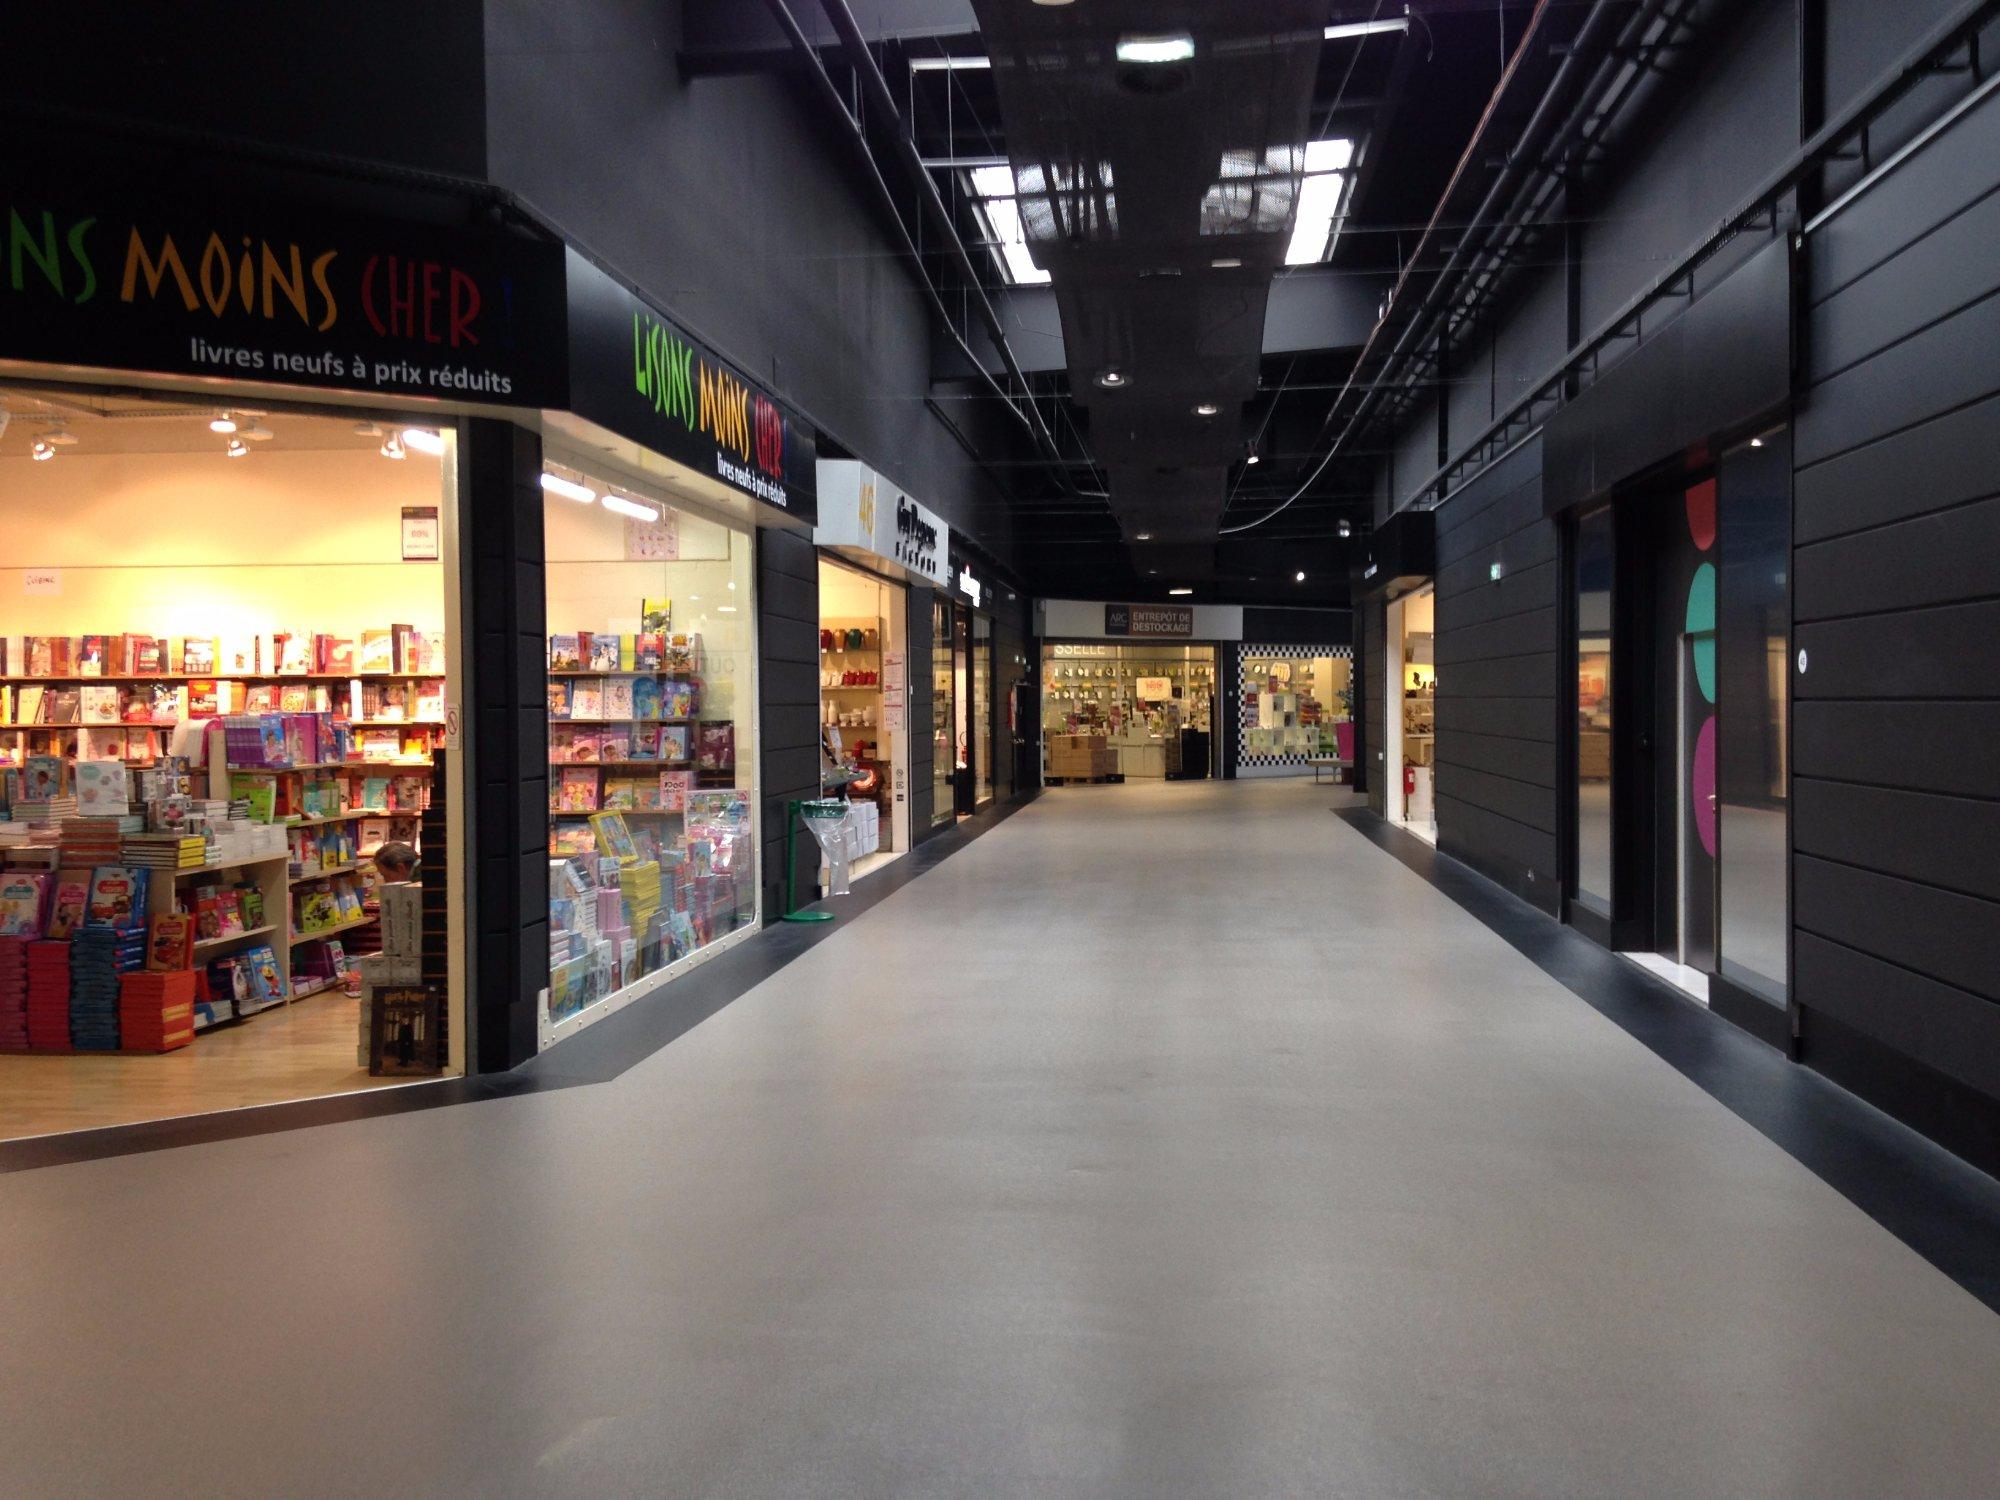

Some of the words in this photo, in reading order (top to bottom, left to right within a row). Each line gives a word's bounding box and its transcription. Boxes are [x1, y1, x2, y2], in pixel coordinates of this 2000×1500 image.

[0, 206, 97, 304] NS
[361, 255, 482, 348] CHER
[190, 337, 264, 369] livres
[273, 350, 344, 376] neufs
[352, 356, 366, 378] à
[375, 361, 422, 385] prix
[430, 365, 512, 394] réduits
[717, 450, 734, 481] livres
[735, 466, 751, 490] neufs
[757, 476, 768, 498] prix
[768, 481, 787, 508] réduits
[1110, 613, 1128, 623] ARC
[1132, 623, 1190, 633] DESTOCKAGE
[1179, 612, 1190, 622] DE
